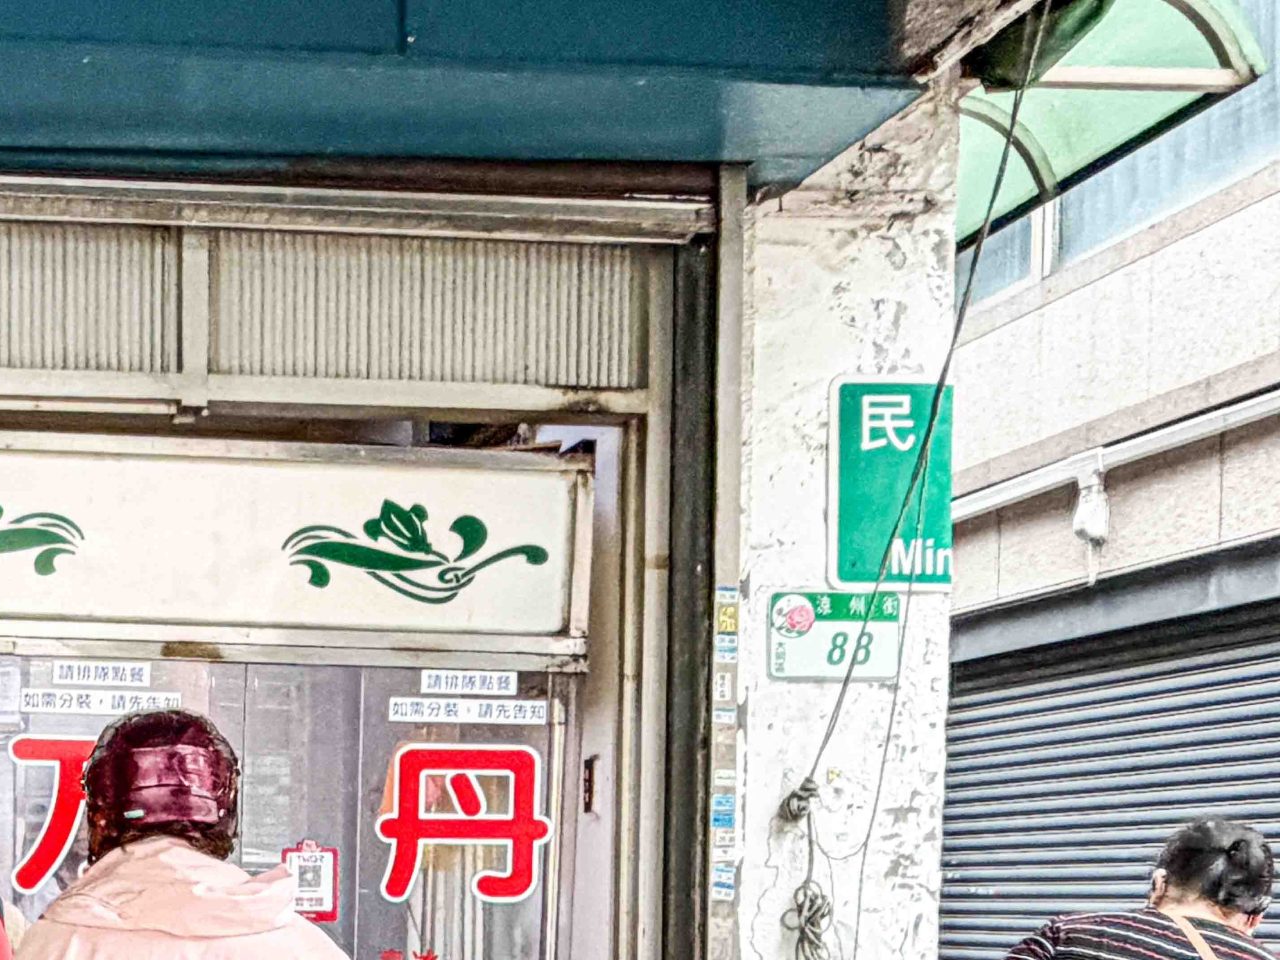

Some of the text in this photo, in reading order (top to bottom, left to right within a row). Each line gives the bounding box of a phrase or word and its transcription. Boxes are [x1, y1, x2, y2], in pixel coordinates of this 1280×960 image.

[861, 394, 916, 451] 民
[891, 538, 952, 576] Min
[827, 631, 873, 665] 88
[58, 664, 144, 683] 請排隊點餐
[427, 673, 512, 691] 請排隊點餐
